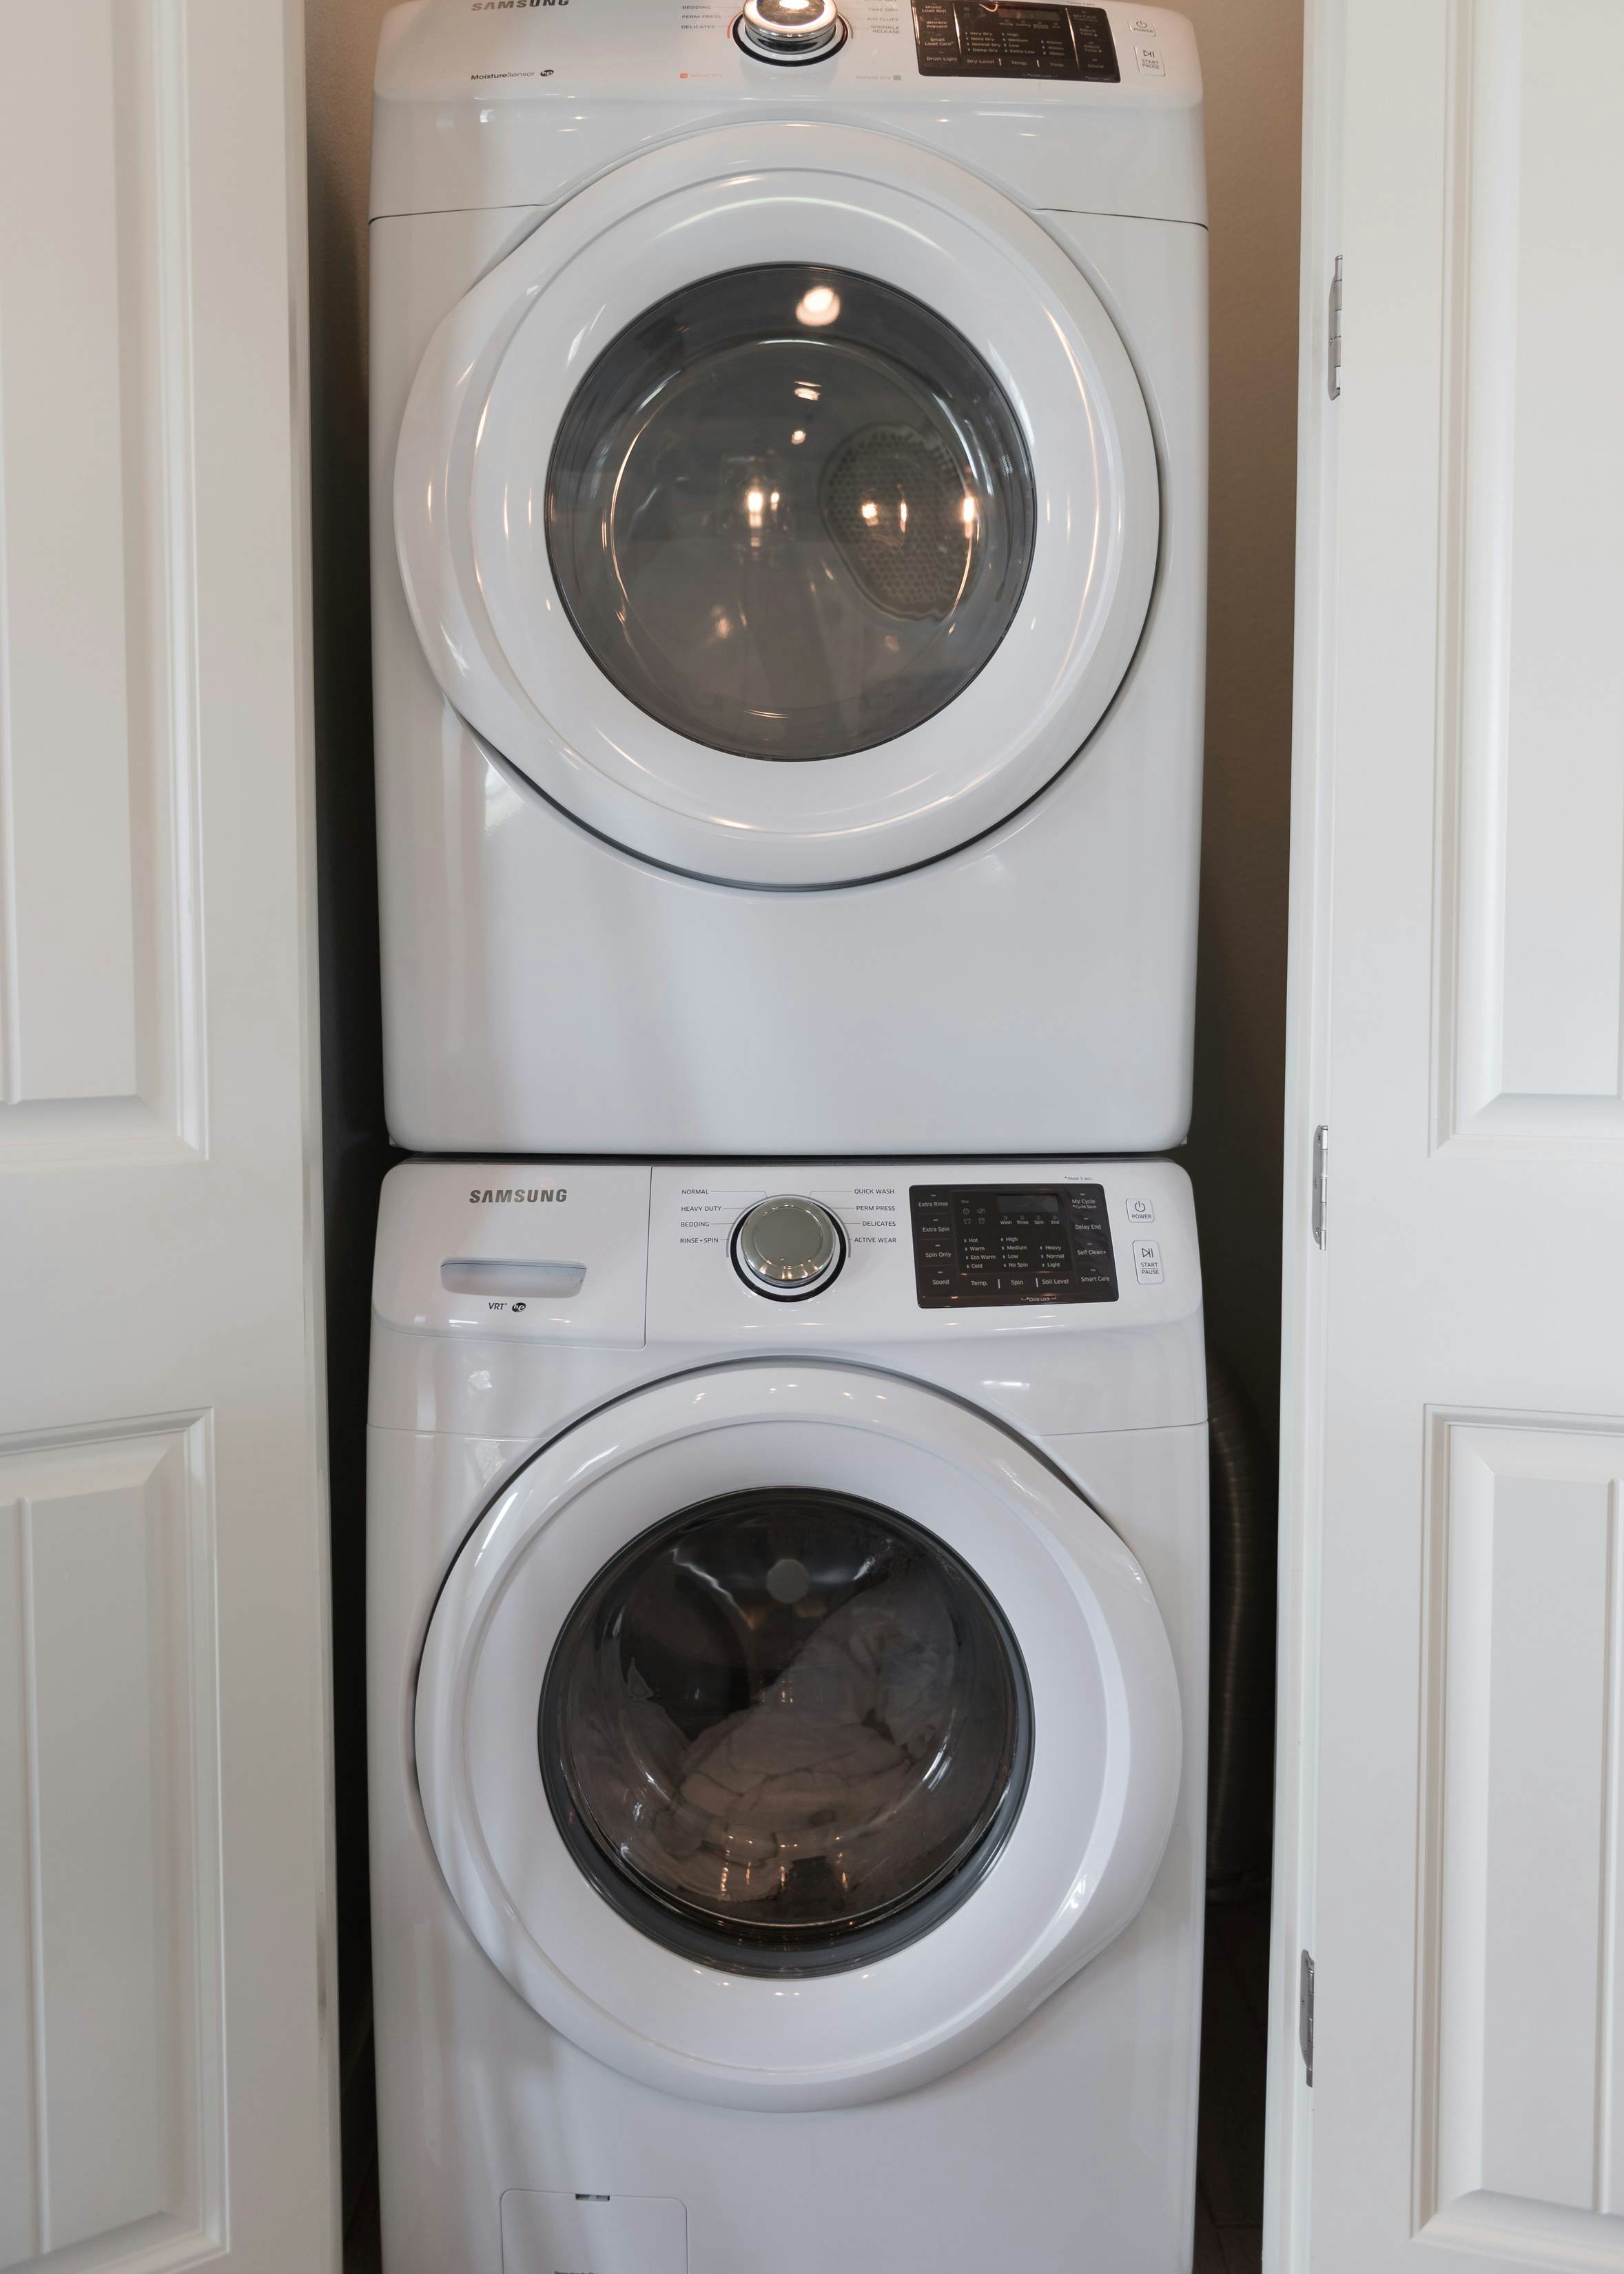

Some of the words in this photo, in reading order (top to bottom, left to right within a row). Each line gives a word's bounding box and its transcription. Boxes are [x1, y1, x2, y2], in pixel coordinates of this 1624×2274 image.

[471, 0, 569, 10] SAMSUNG
[471, 71, 535, 80] MoistureSensor
[469, 1189, 568, 1204] SAMSUNG
